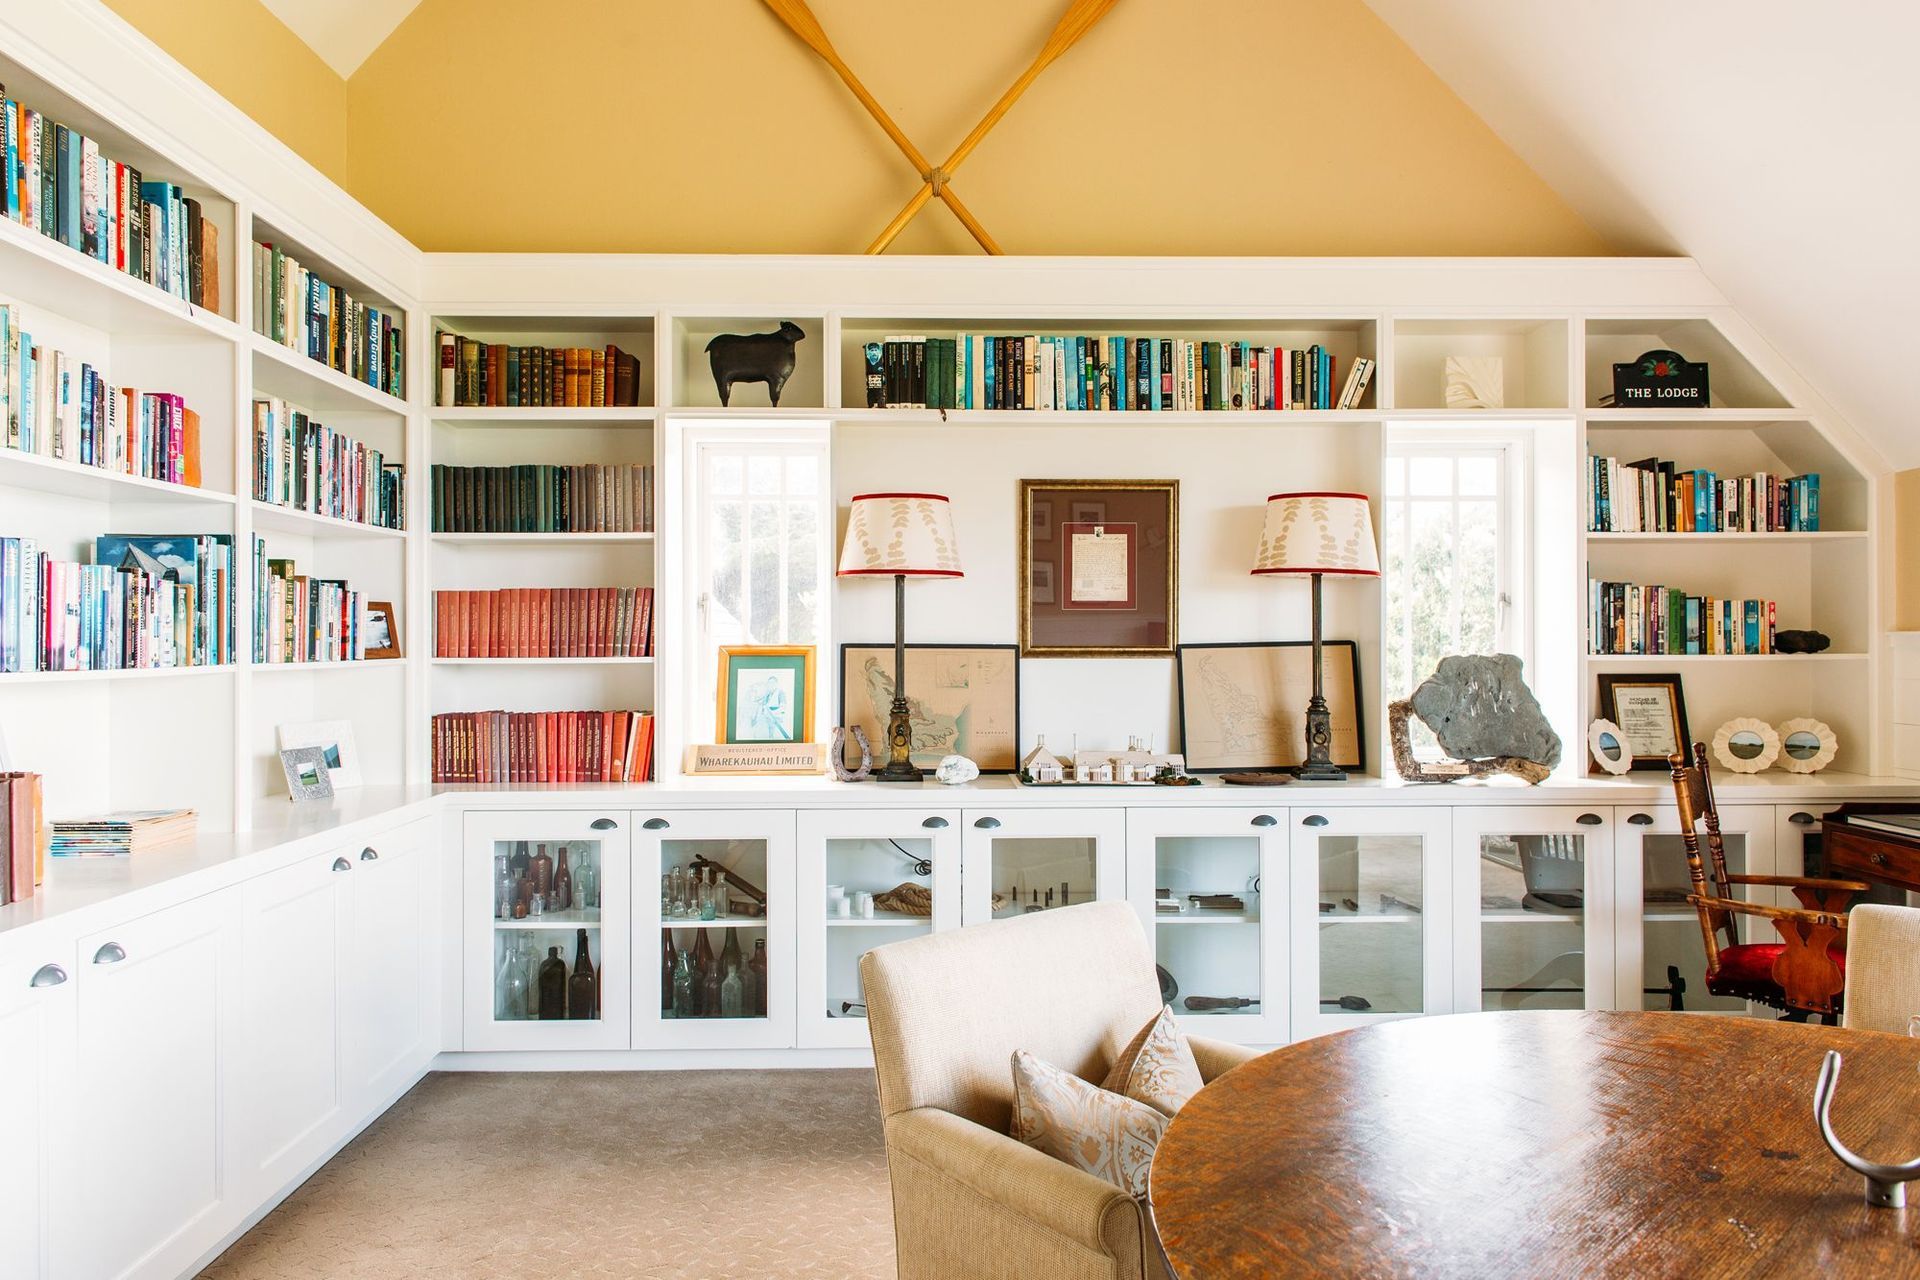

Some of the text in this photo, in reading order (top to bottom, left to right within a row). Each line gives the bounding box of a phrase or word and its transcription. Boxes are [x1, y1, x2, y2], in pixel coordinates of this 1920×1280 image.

[369, 318, 378, 344] Andy
[1625, 387, 1698, 398] THE LODGE
[172, 406, 182, 430] QUIZ
[700, 756, 813, 766] WHAREKAUHAU LIMITED
